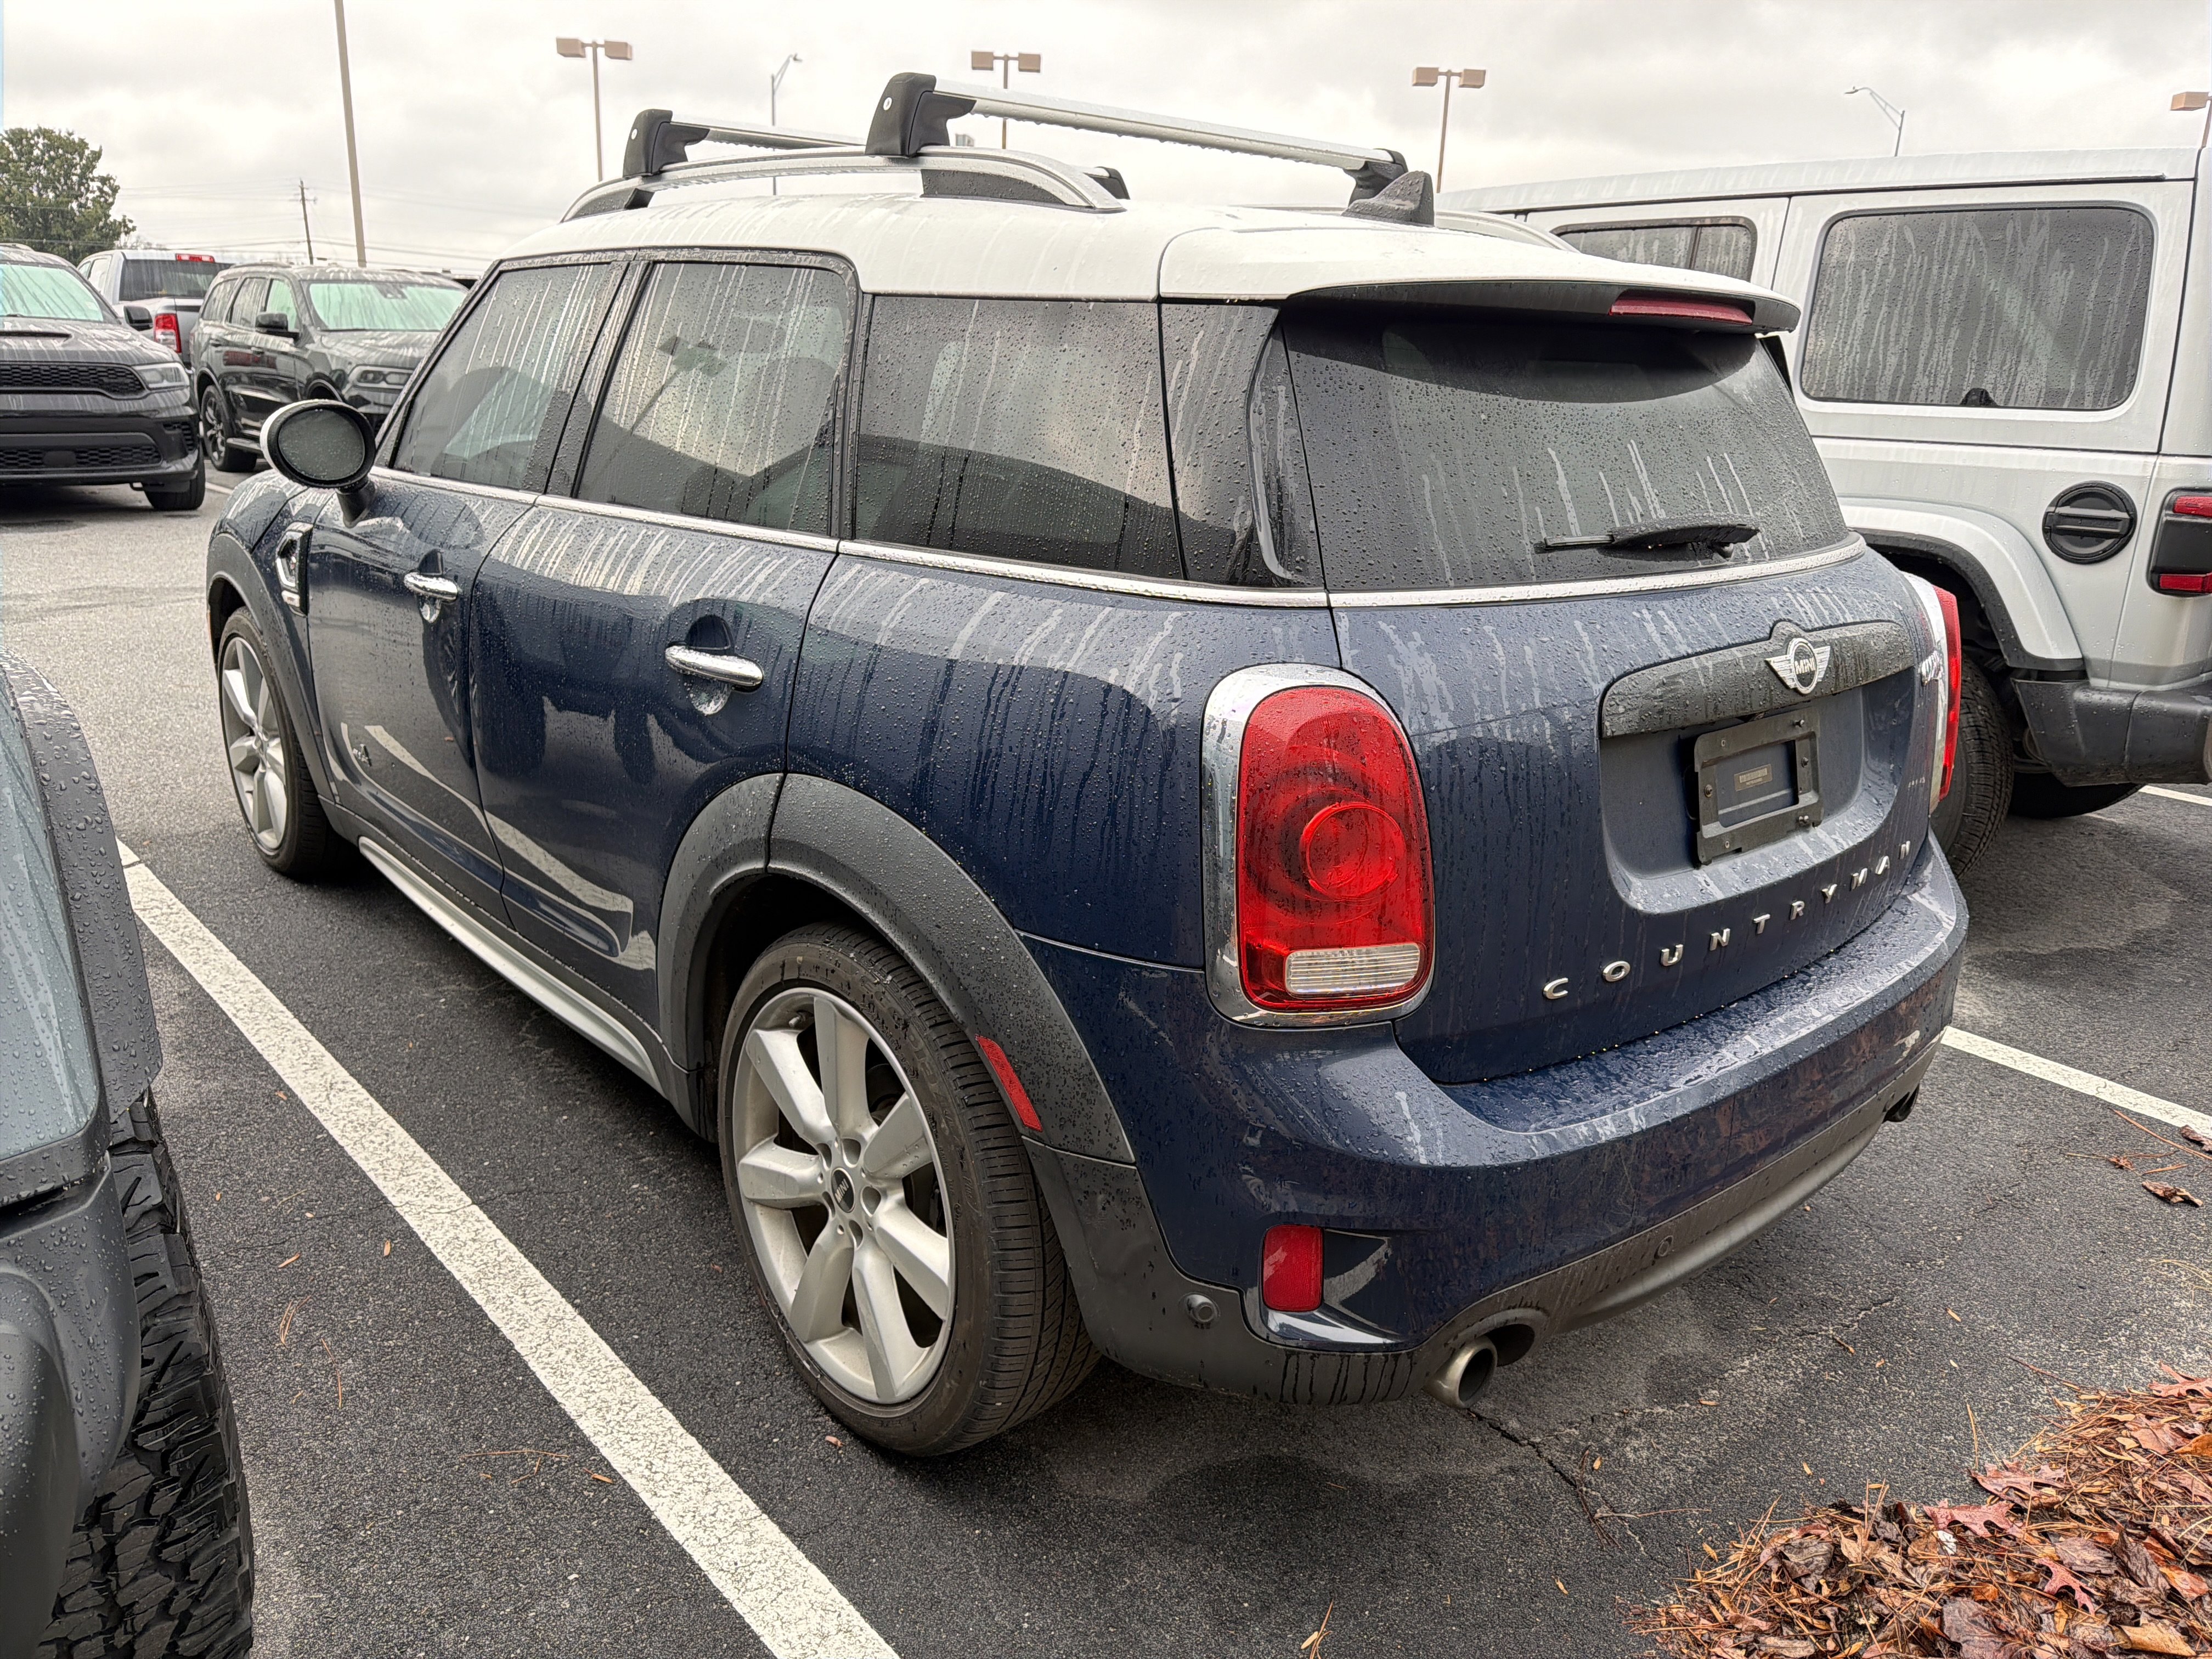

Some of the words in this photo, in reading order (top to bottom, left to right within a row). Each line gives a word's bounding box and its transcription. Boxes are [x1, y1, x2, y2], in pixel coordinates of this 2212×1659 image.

[1794, 657, 1816, 675] MINI
[1543, 840, 1910, 1000] COUNTRYMAN
[834, 1178, 849, 1203] MINI
